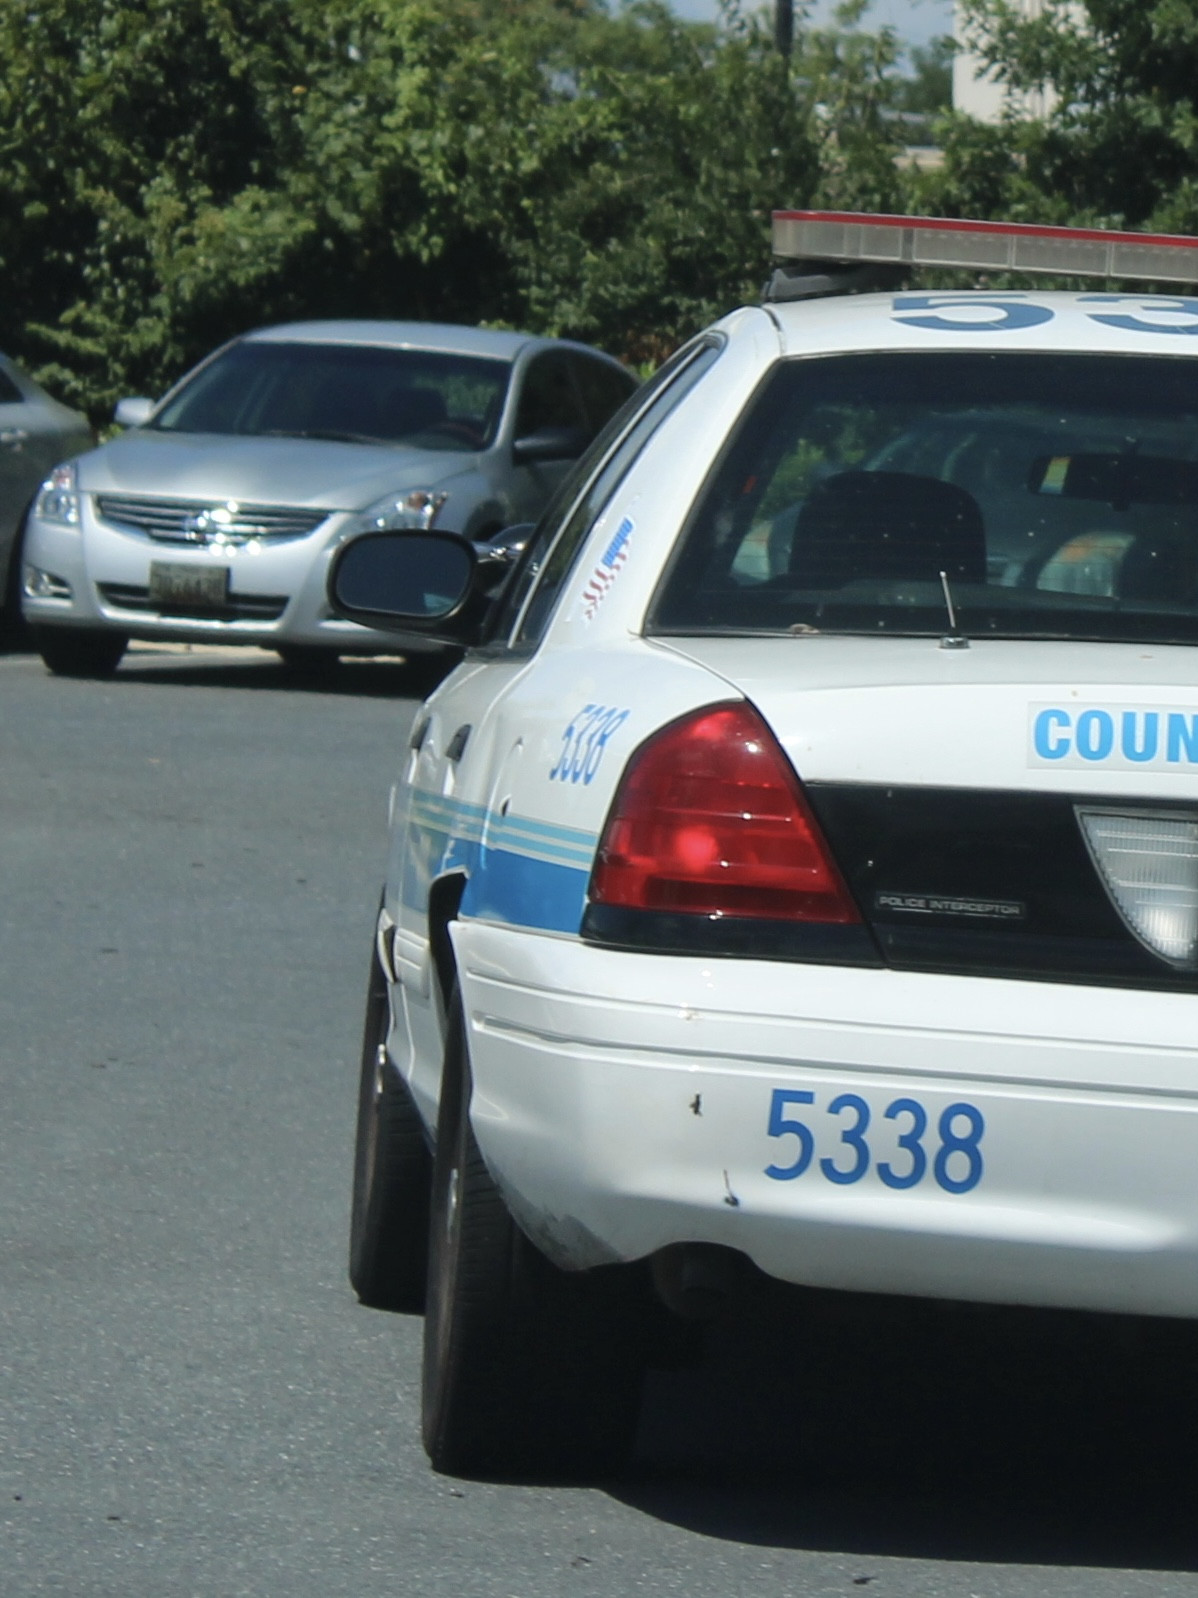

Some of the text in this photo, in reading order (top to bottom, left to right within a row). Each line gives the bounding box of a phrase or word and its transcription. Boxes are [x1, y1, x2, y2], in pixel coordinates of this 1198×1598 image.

[549, 704, 631, 786] 5338
[879, 896, 1020, 914] POLICE INTERCEPTOR
[763, 1088, 985, 1194] 5338
